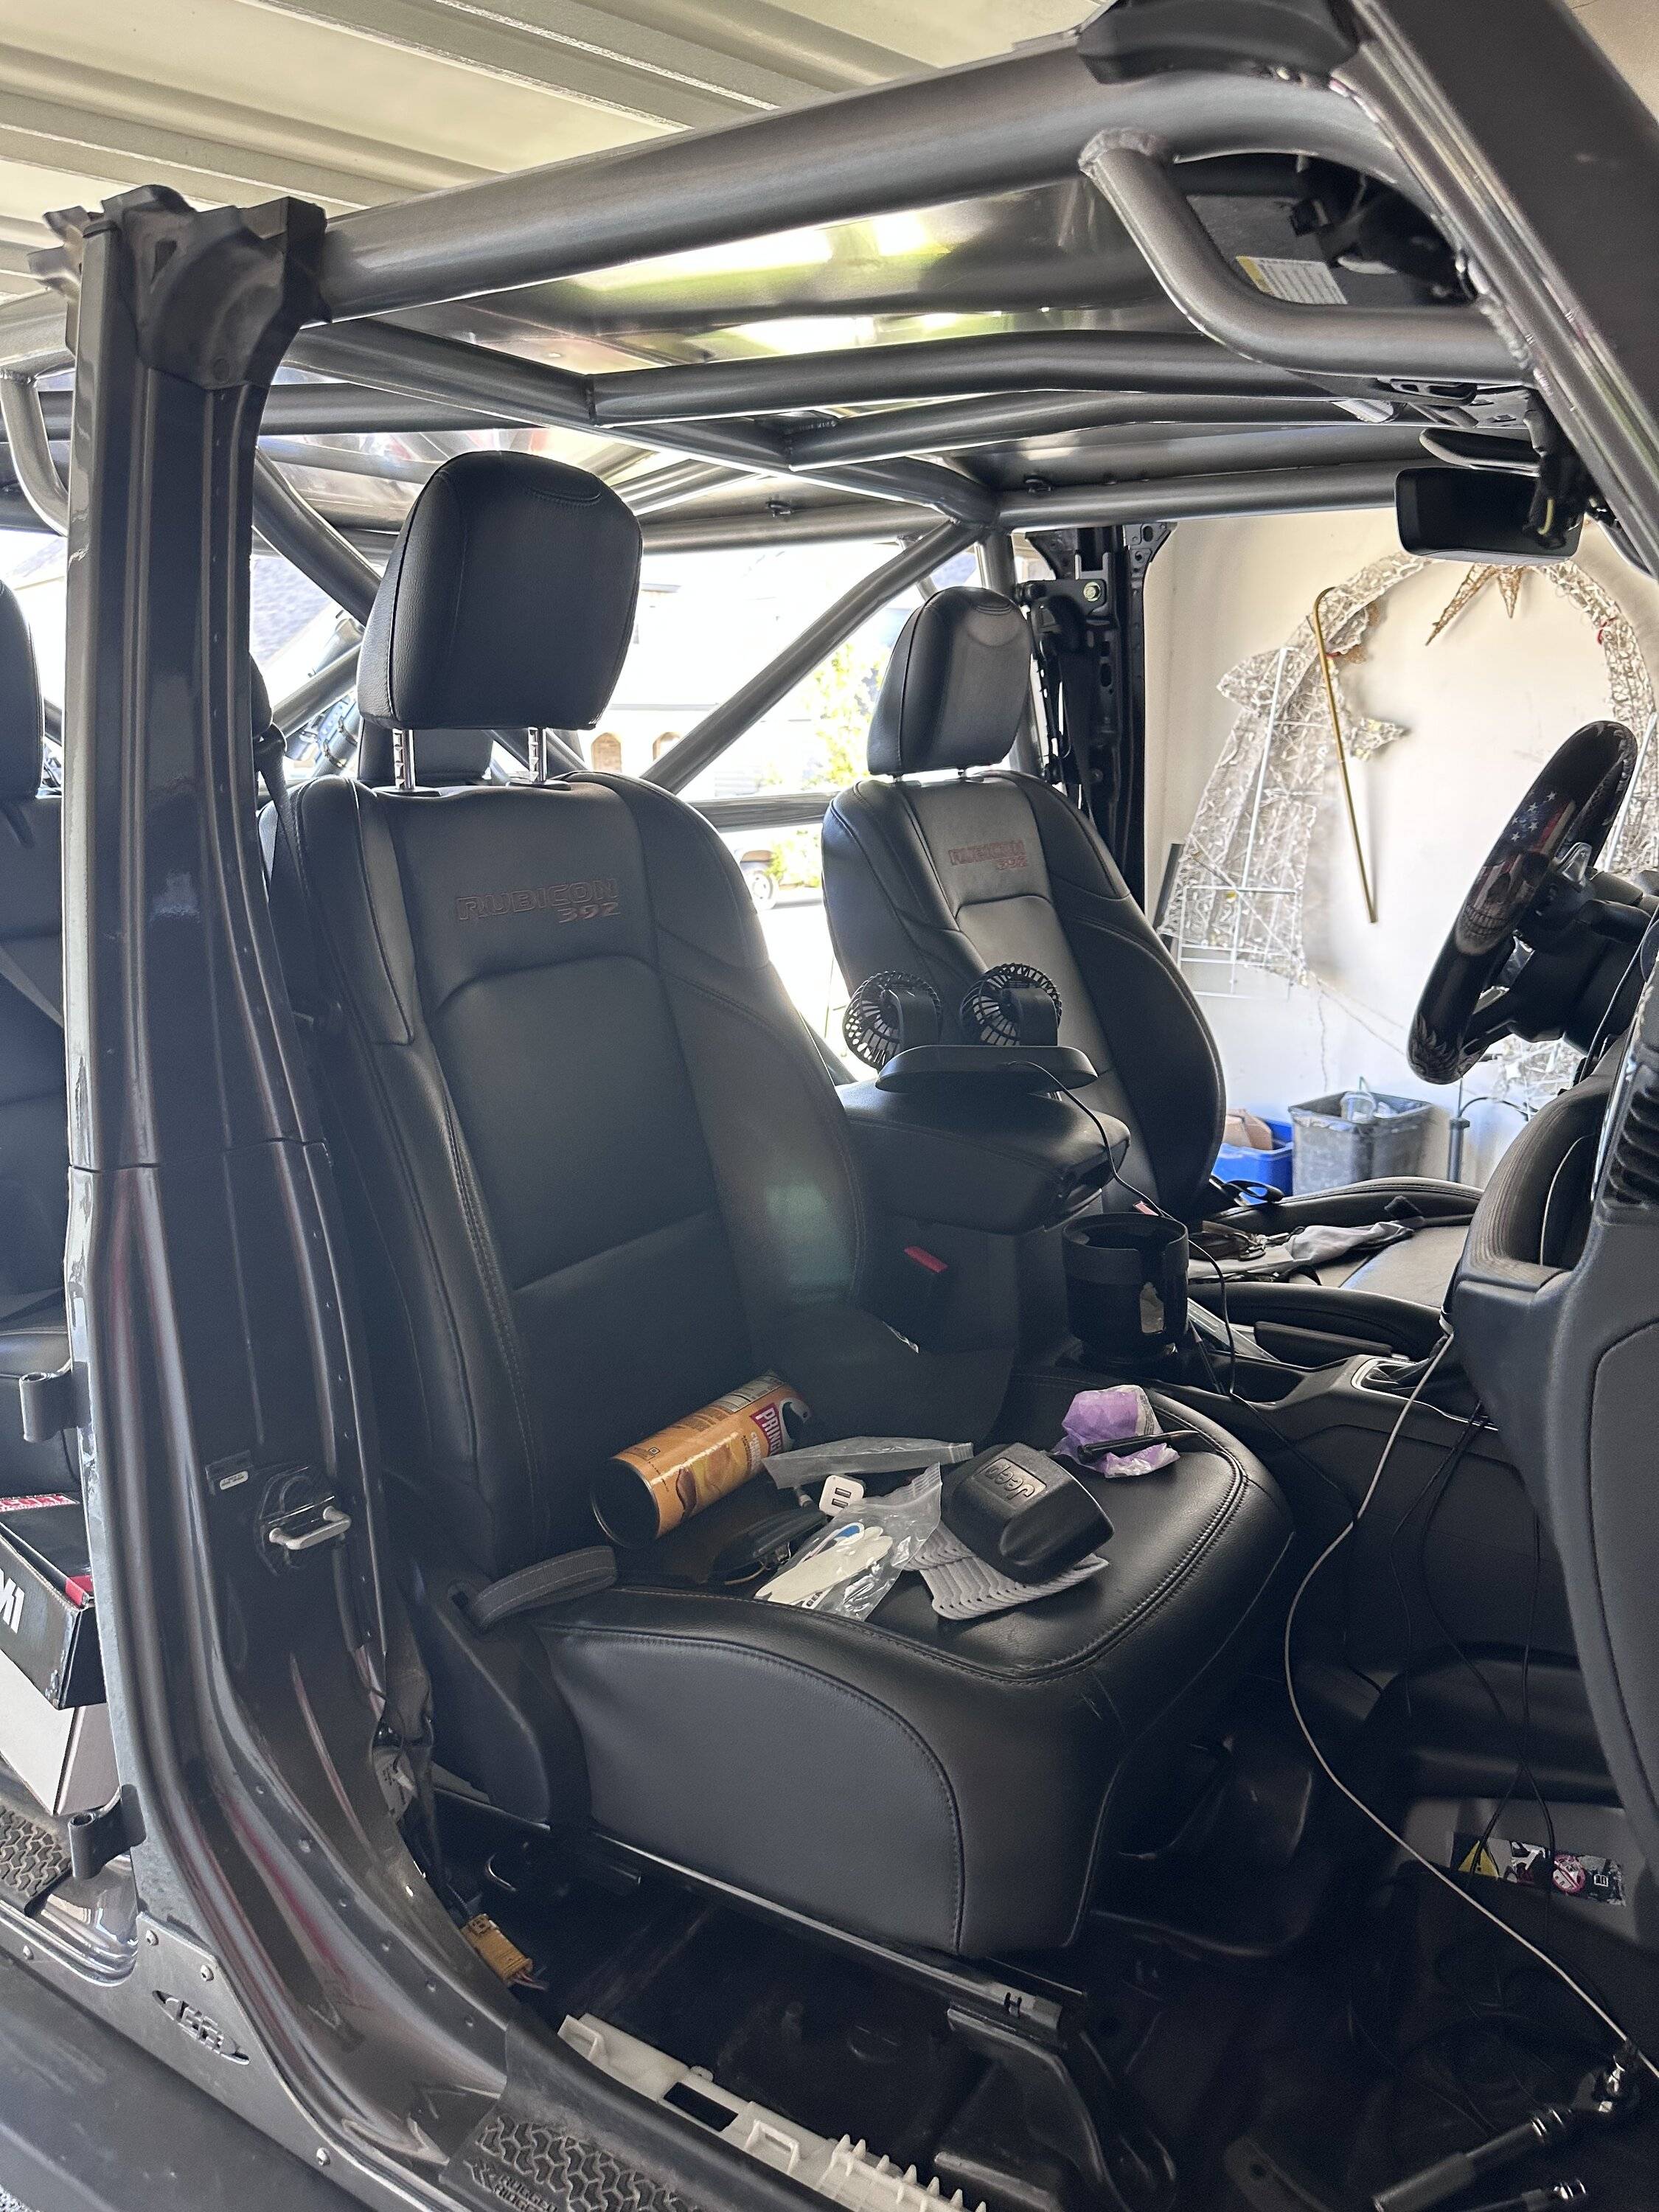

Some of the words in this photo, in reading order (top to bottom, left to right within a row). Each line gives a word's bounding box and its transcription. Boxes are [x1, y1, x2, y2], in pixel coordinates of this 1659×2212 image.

[456, 878, 619, 920] RUBICON
[557, 902, 621, 923] 392
[985, 1464, 1035, 1500] Jeep
